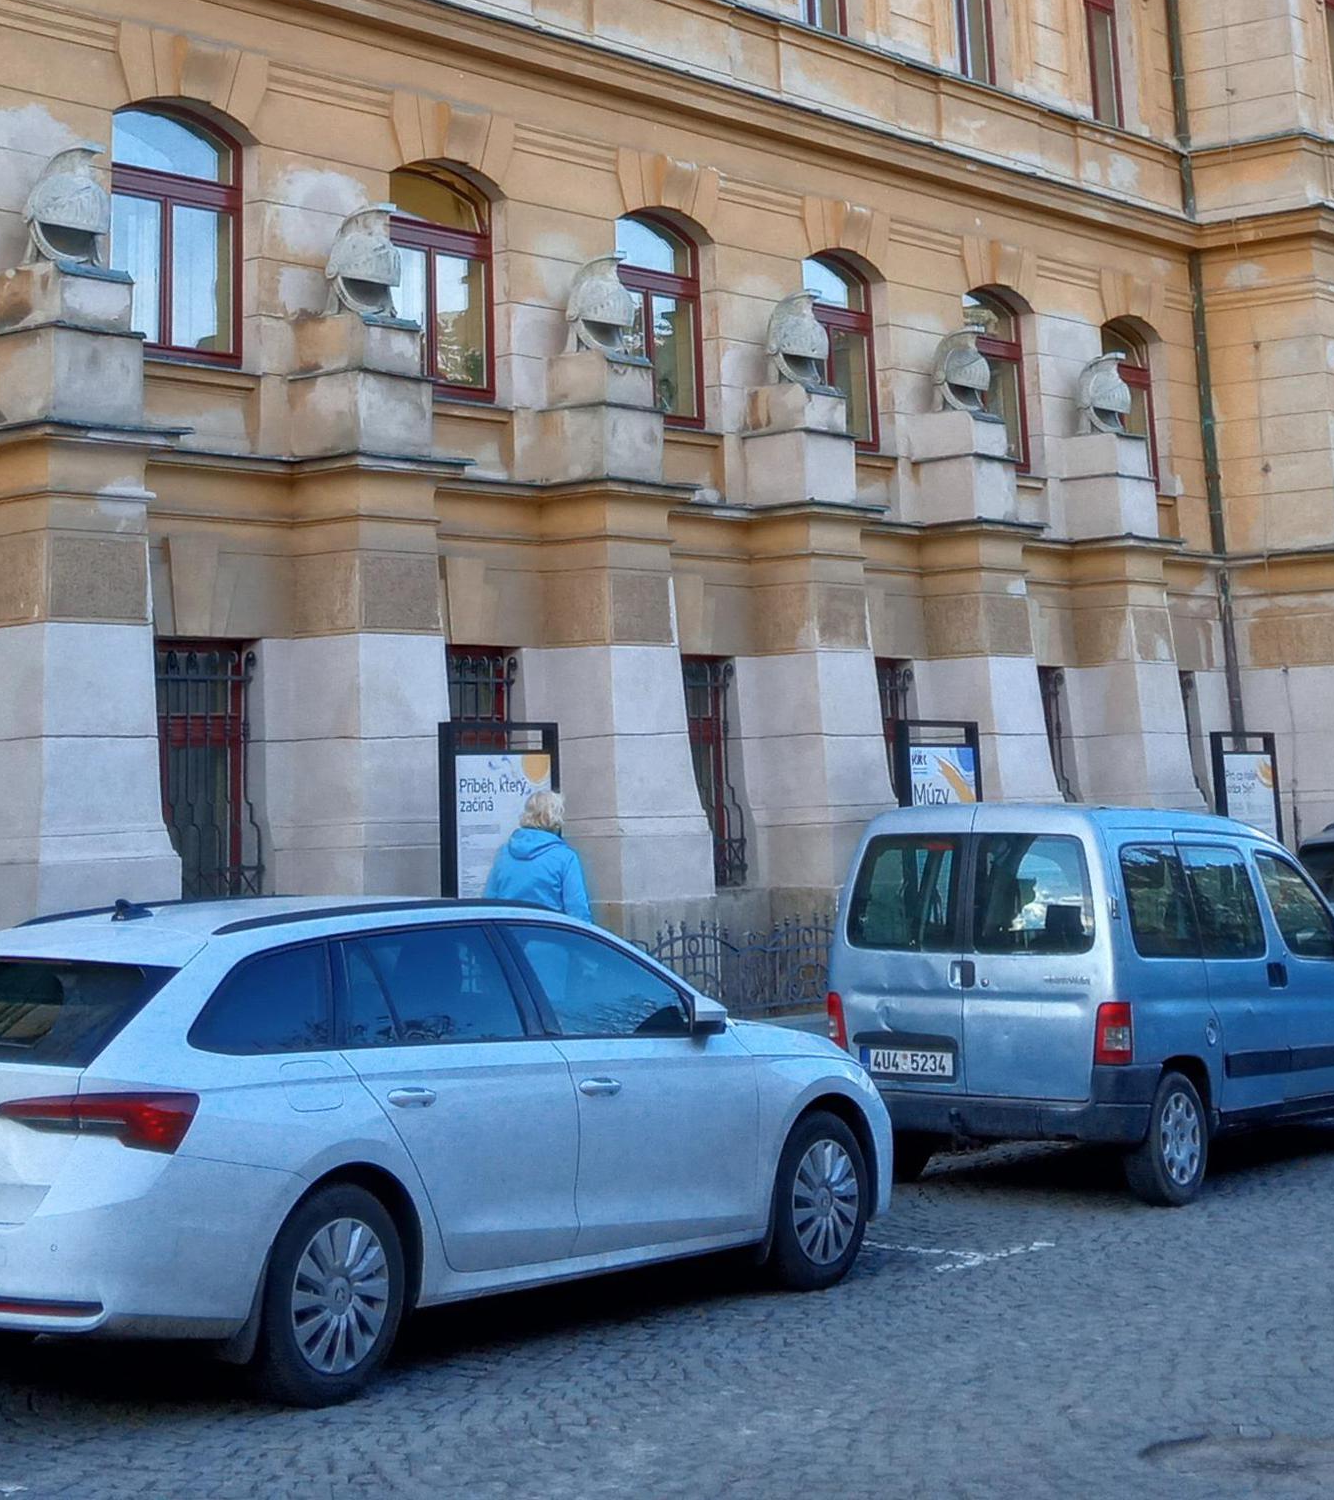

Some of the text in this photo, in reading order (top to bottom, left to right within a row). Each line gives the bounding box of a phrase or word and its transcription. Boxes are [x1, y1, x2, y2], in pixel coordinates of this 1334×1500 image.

[913, 782, 950, 804] Múzy
[873, 1051, 946, 1074] 4U4 5234
